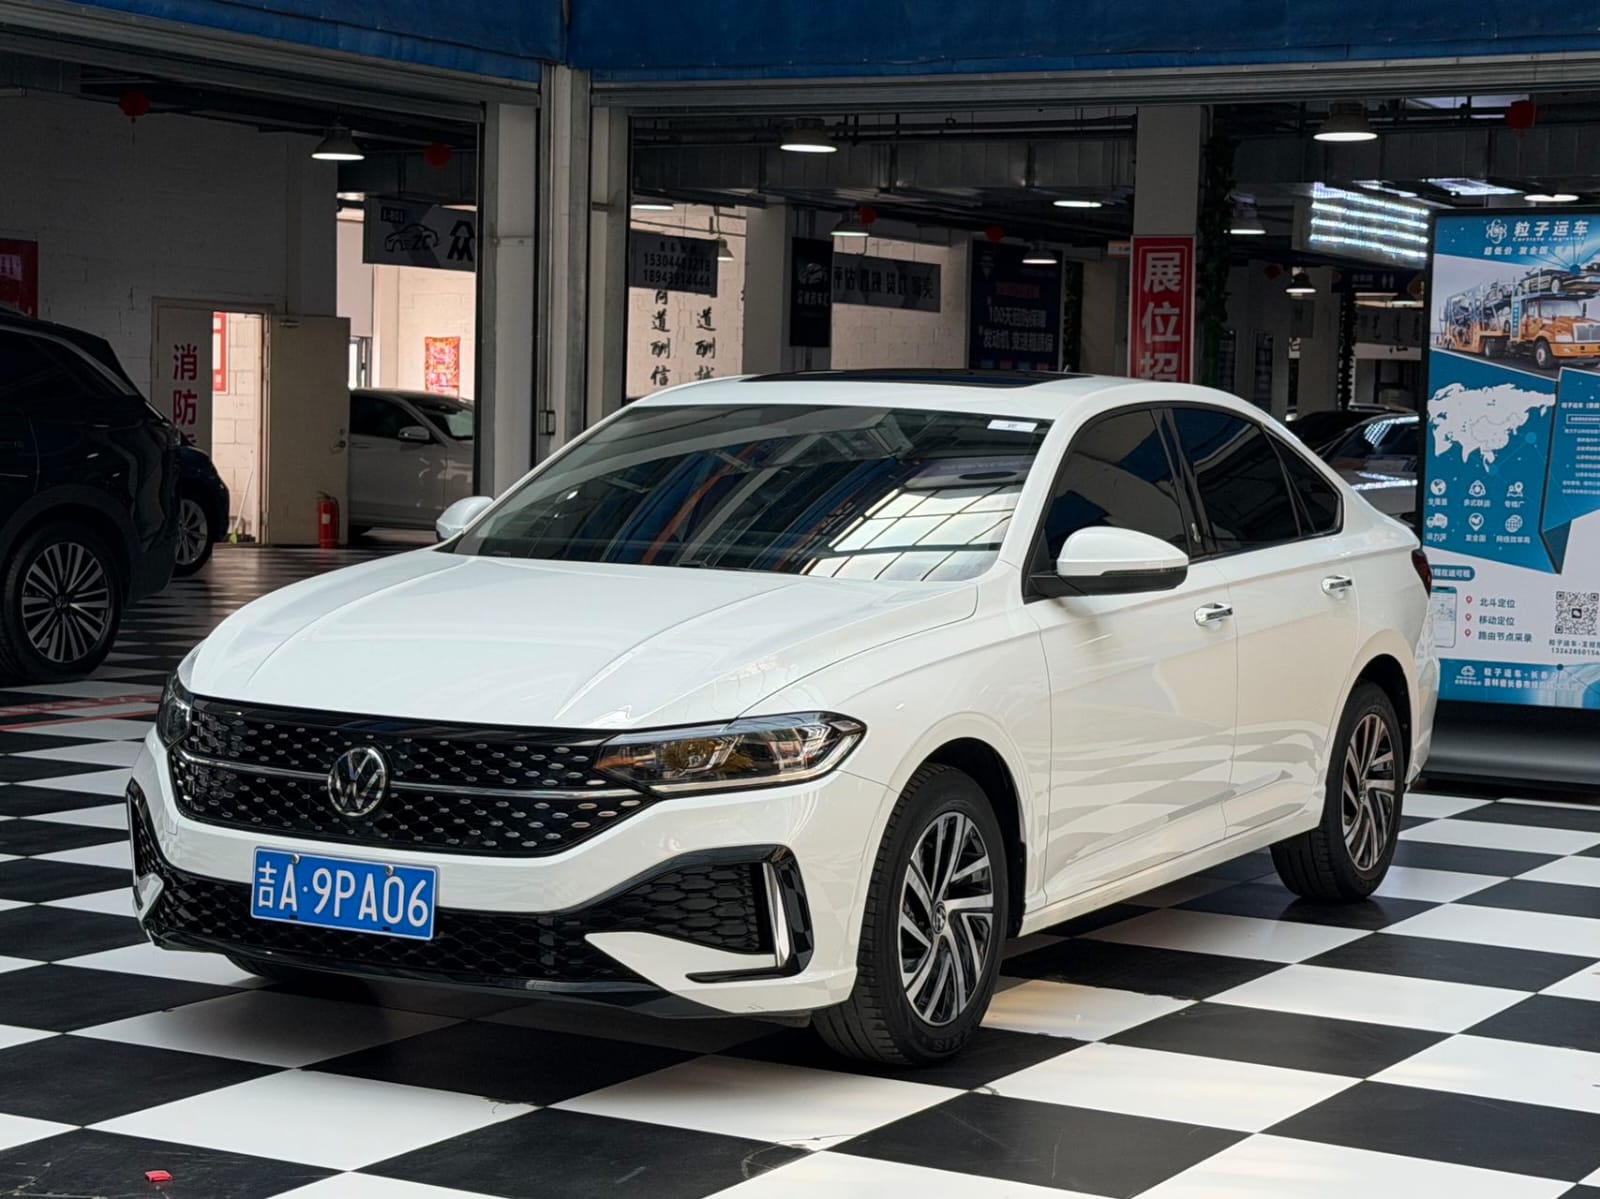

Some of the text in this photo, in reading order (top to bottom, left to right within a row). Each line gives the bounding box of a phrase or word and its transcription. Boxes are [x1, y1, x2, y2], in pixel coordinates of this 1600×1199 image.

[1514, 220, 1589, 236] 粒子运车
[447, 220, 475, 261] 众
[1479, 598, 1516, 609] 北斗定位
[1478, 615, 1515, 626] 移动定位
[257, 861, 429, 928] 吉A·9PA06
